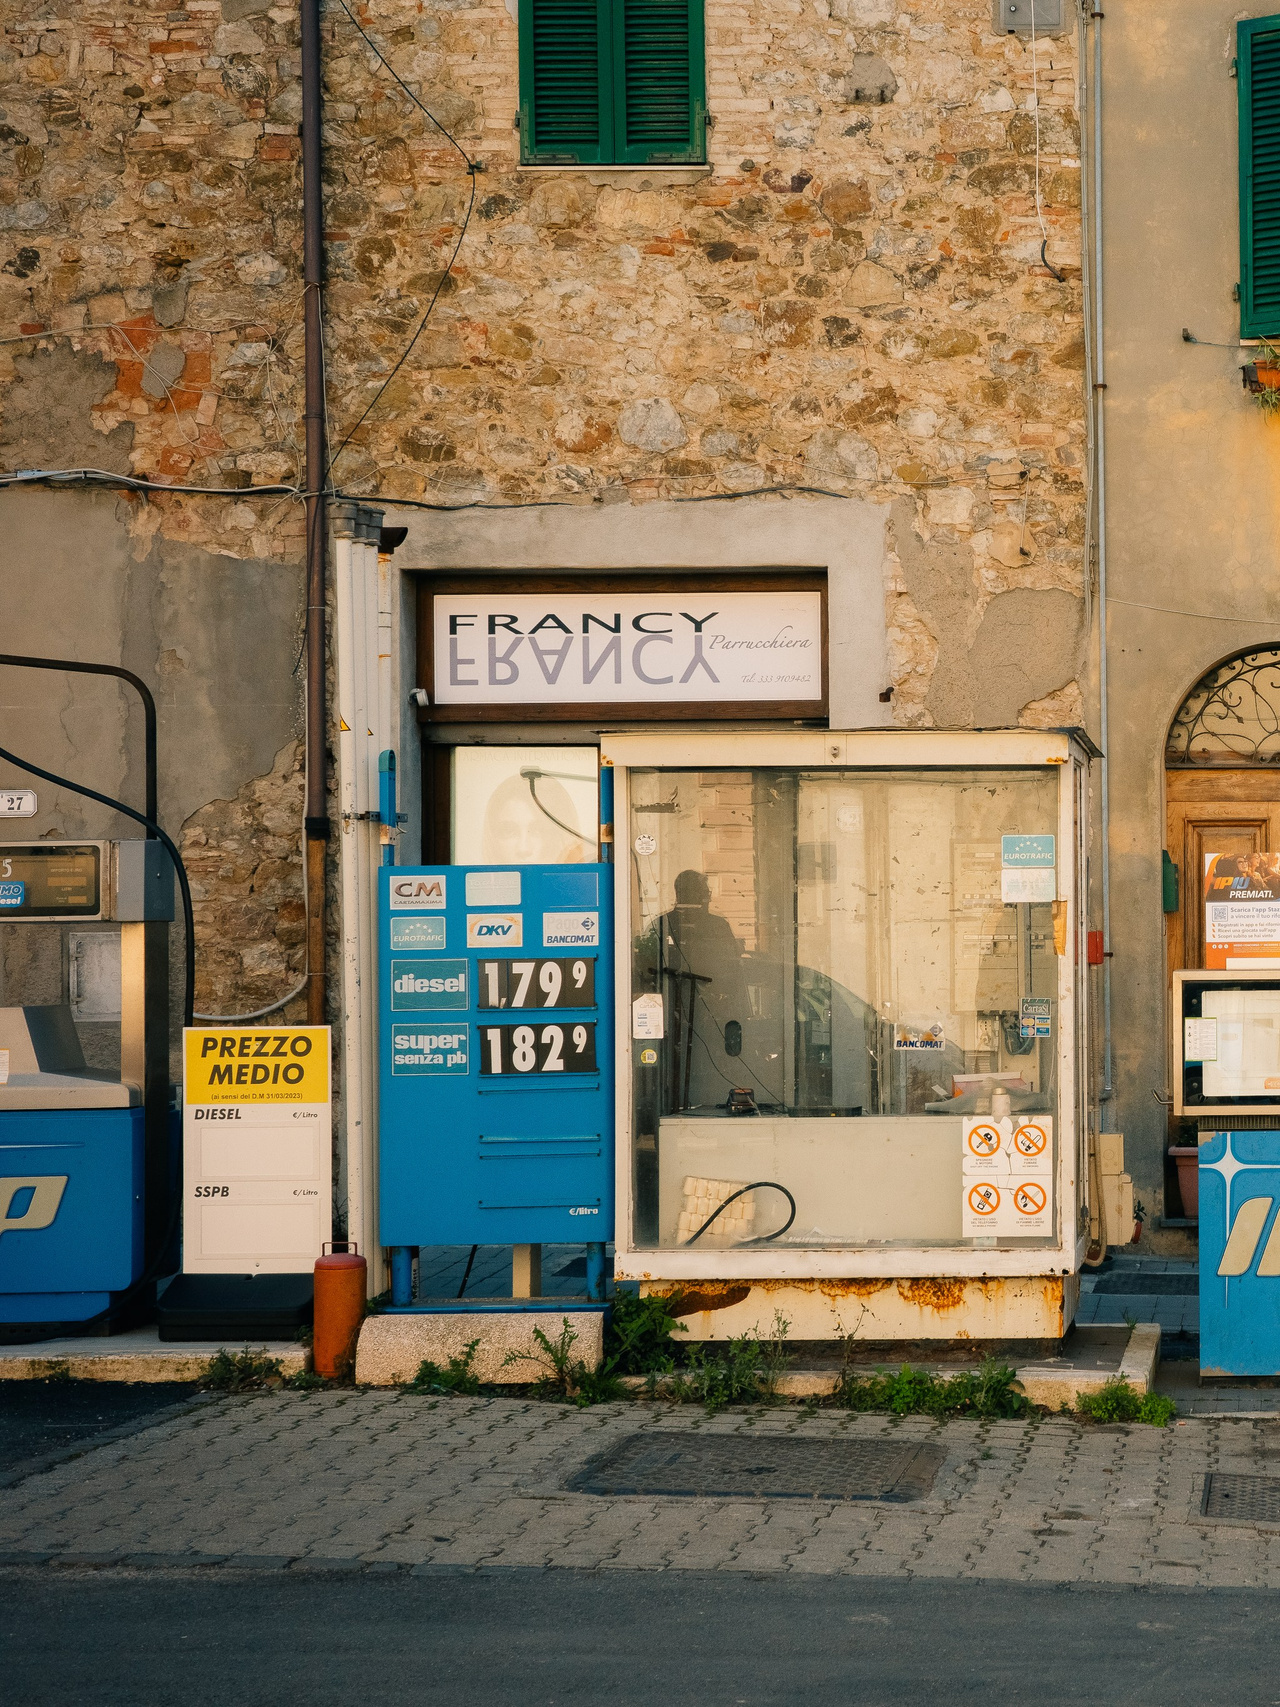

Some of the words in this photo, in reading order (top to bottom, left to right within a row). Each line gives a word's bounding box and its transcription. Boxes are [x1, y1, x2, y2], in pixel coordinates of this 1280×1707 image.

[450, 612, 719, 635] FRANCY
[709, 625, 812, 649] Parrucchiera
[7, 797, 24, 811] 27
[2, 859, 12, 878] 5
[394, 882, 442, 897] CM
[1229, 890, 1274, 898] PREMIATI.
[477, 925, 513, 936] DKV
[547, 935, 595, 944] BANCOMAT
[394, 973, 465, 993] diesel
[201, 1035, 312, 1058] PREZZO
[394, 1034, 467, 1054] super
[896, 1040, 944, 1049] BANCOMAT
[394, 1054, 443, 1065] senza
[447, 1051, 467, 1067] pb
[208, 1063, 305, 1085] MEDIO
[266, 1092, 303, 1100] 31/03/2023)
[194, 1109, 242, 1120] DIESEL
[194, 1186, 230, 1198] SSPB
[569, 1207, 599, 1216] €/litro
